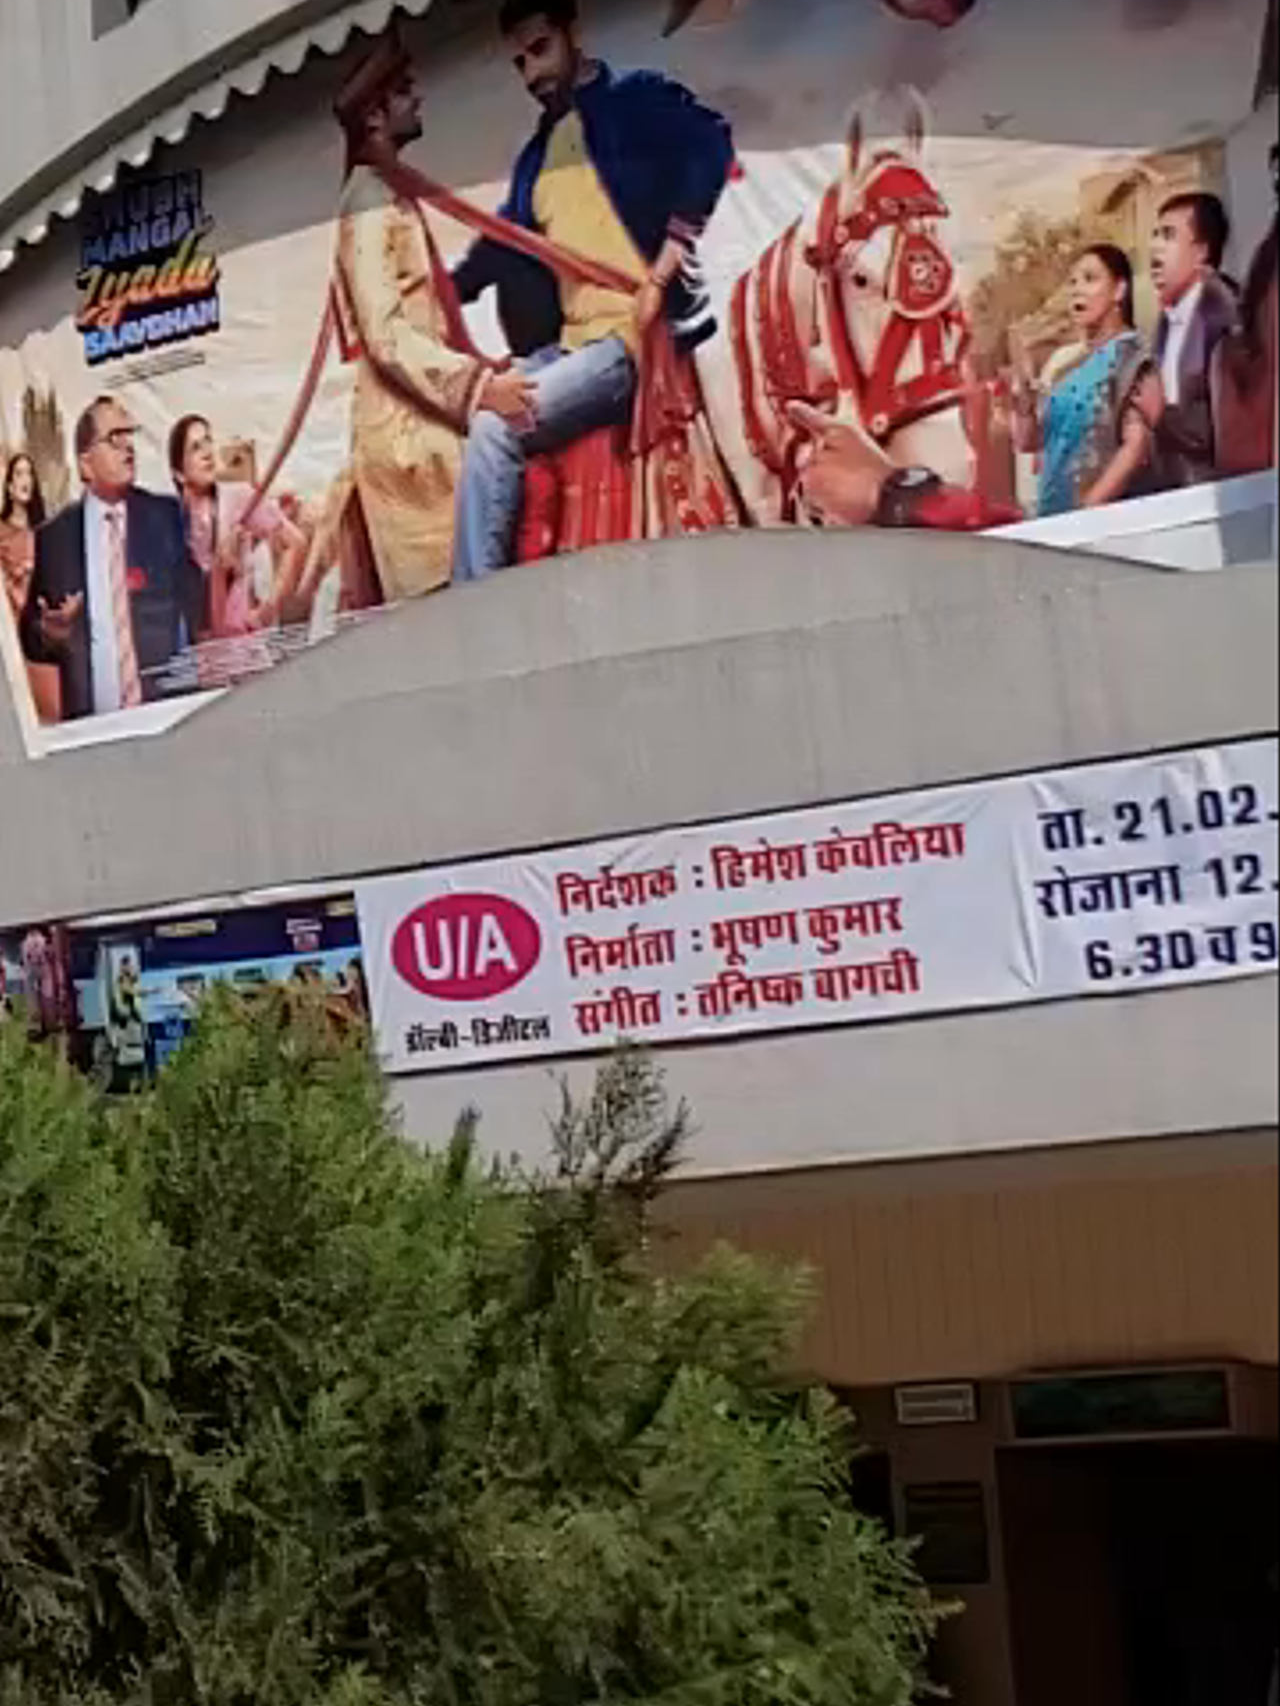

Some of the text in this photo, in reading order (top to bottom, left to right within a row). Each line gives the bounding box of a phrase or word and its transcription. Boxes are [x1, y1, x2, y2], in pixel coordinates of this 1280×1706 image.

[82, 205, 216, 266] MANGAL
[1034, 864, 1181, 919] रोजाना
[412, 913, 519, 981] U/A
[565, 922, 675, 978] निर्माता
[710, 911, 799, 966] भूषण
[802, 897, 903, 955] कुमार
[1084, 929, 1196, 981] 6.30
[572, 986, 661, 1035] संगीत
